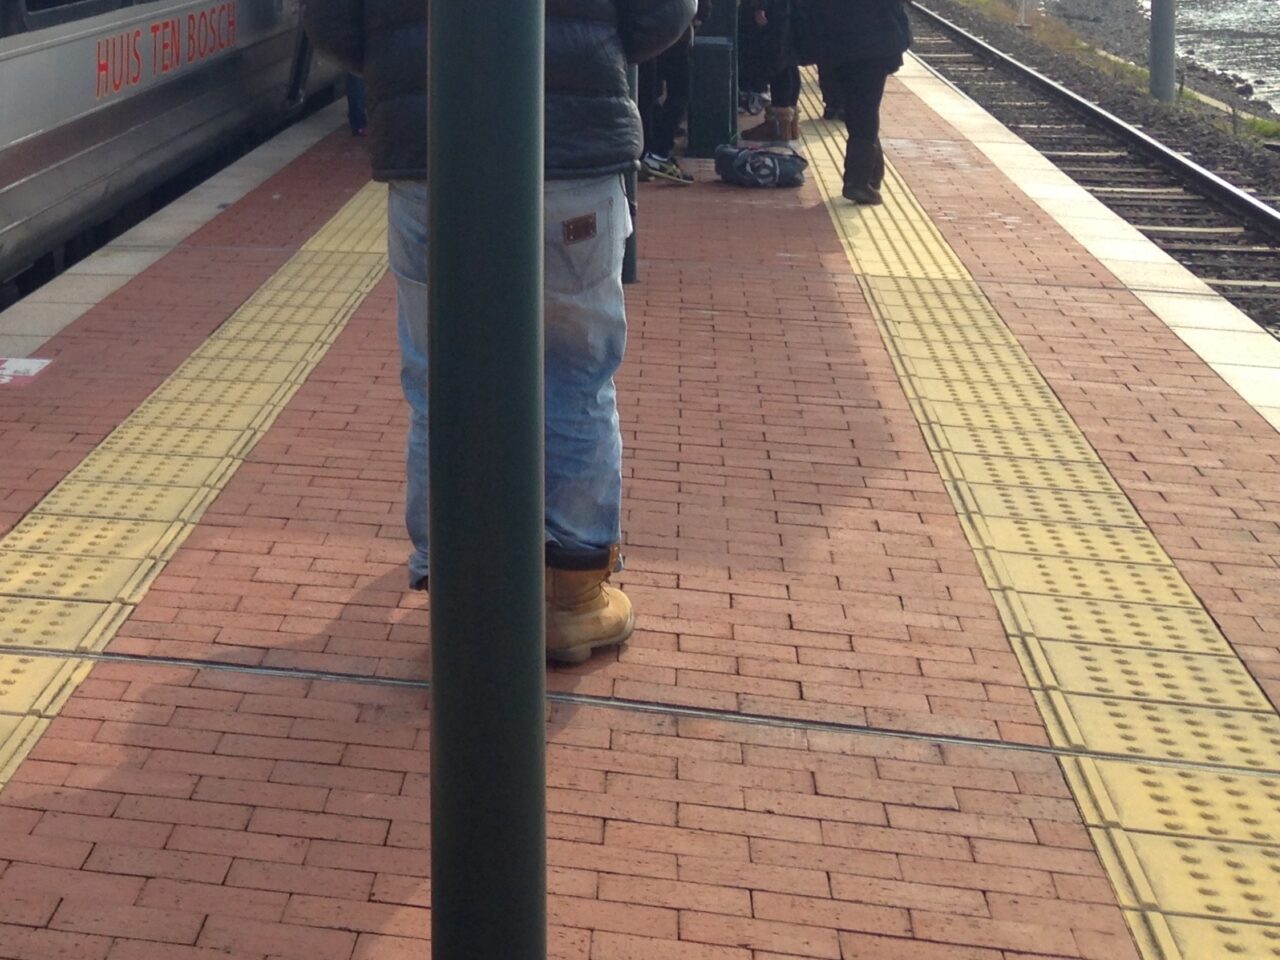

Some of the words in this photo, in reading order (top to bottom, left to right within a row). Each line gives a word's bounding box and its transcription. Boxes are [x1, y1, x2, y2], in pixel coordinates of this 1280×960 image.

[96, 29, 142, 100] HUIS
[150, 16, 182, 78] TEN
[186, 2, 237, 65] BOSCH
